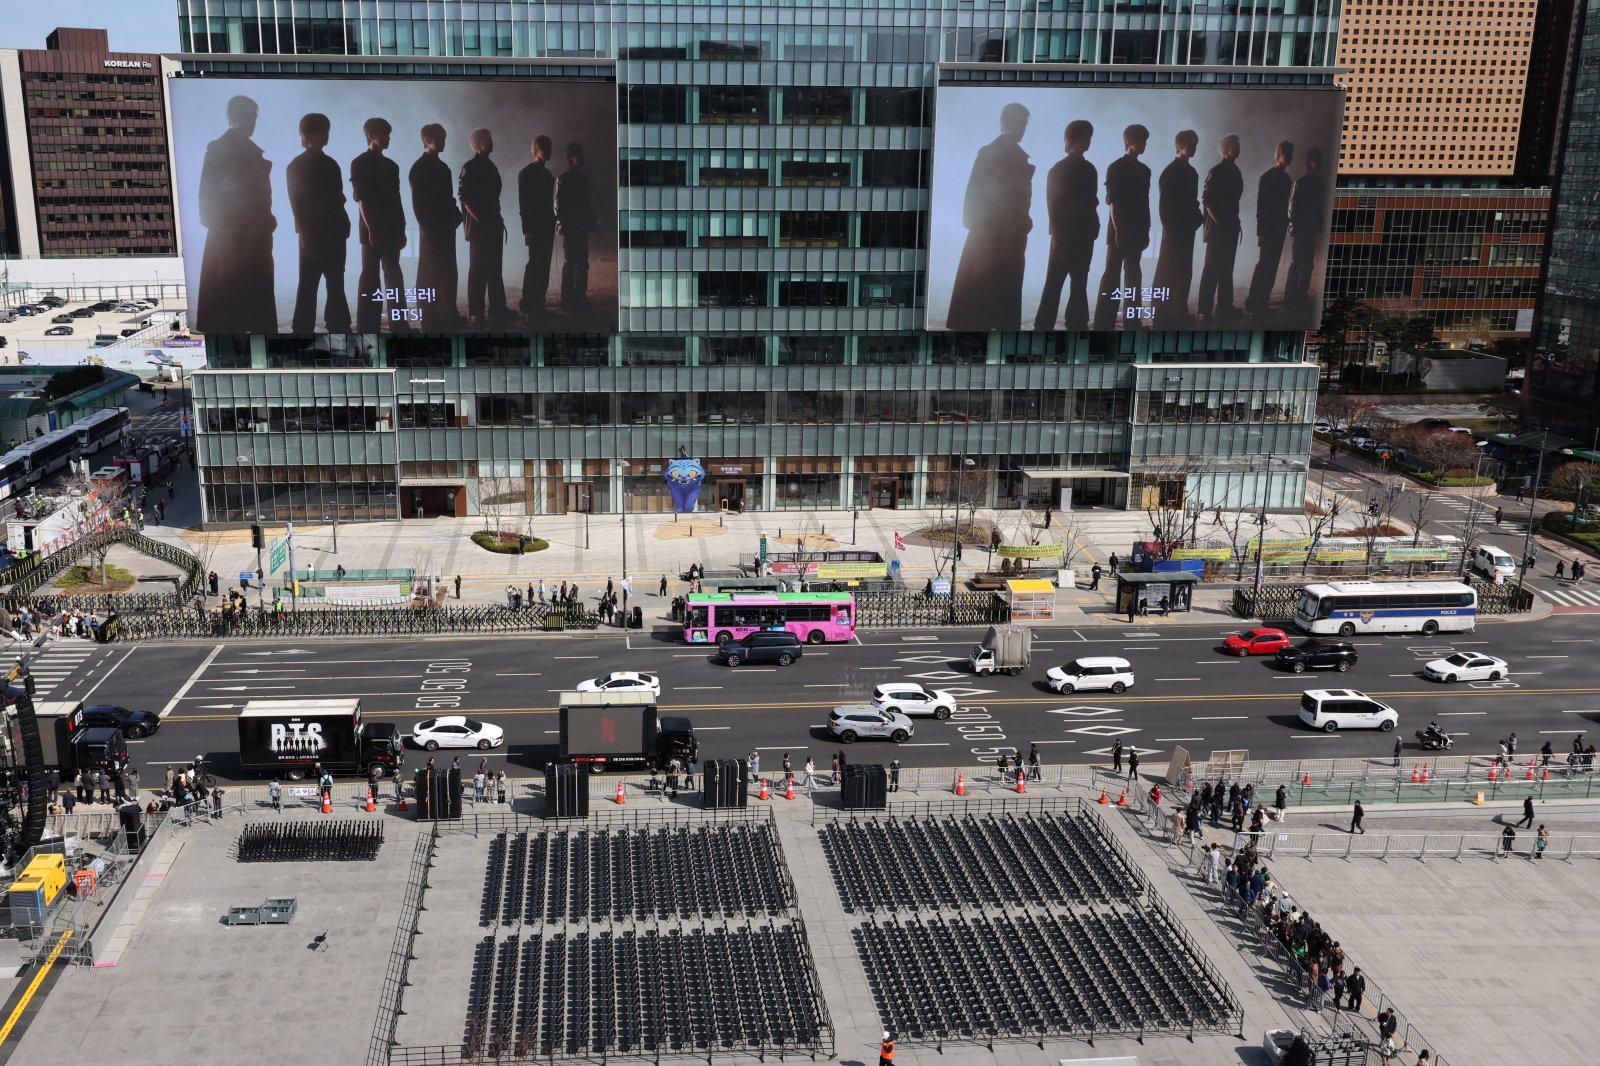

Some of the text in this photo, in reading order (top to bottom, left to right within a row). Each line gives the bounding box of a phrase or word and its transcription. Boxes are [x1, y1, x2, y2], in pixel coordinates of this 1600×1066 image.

[104, 60, 152, 69] KOREAN Re
[371, 287, 400, 303] 소리
[404, 287, 436, 303] 질러!
[1110, 286, 1136, 302] 소리
[1141, 286, 1170, 302] 질러!
[391, 308, 423, 321] BTS!
[1126, 306, 1156, 319] BTS!
[425, 662, 473, 674] 50
[420, 678, 468, 691] 50
[415, 695, 462, 708] 50
[271, 722, 325, 752] BTS
[957, 725, 1007, 741] 50
